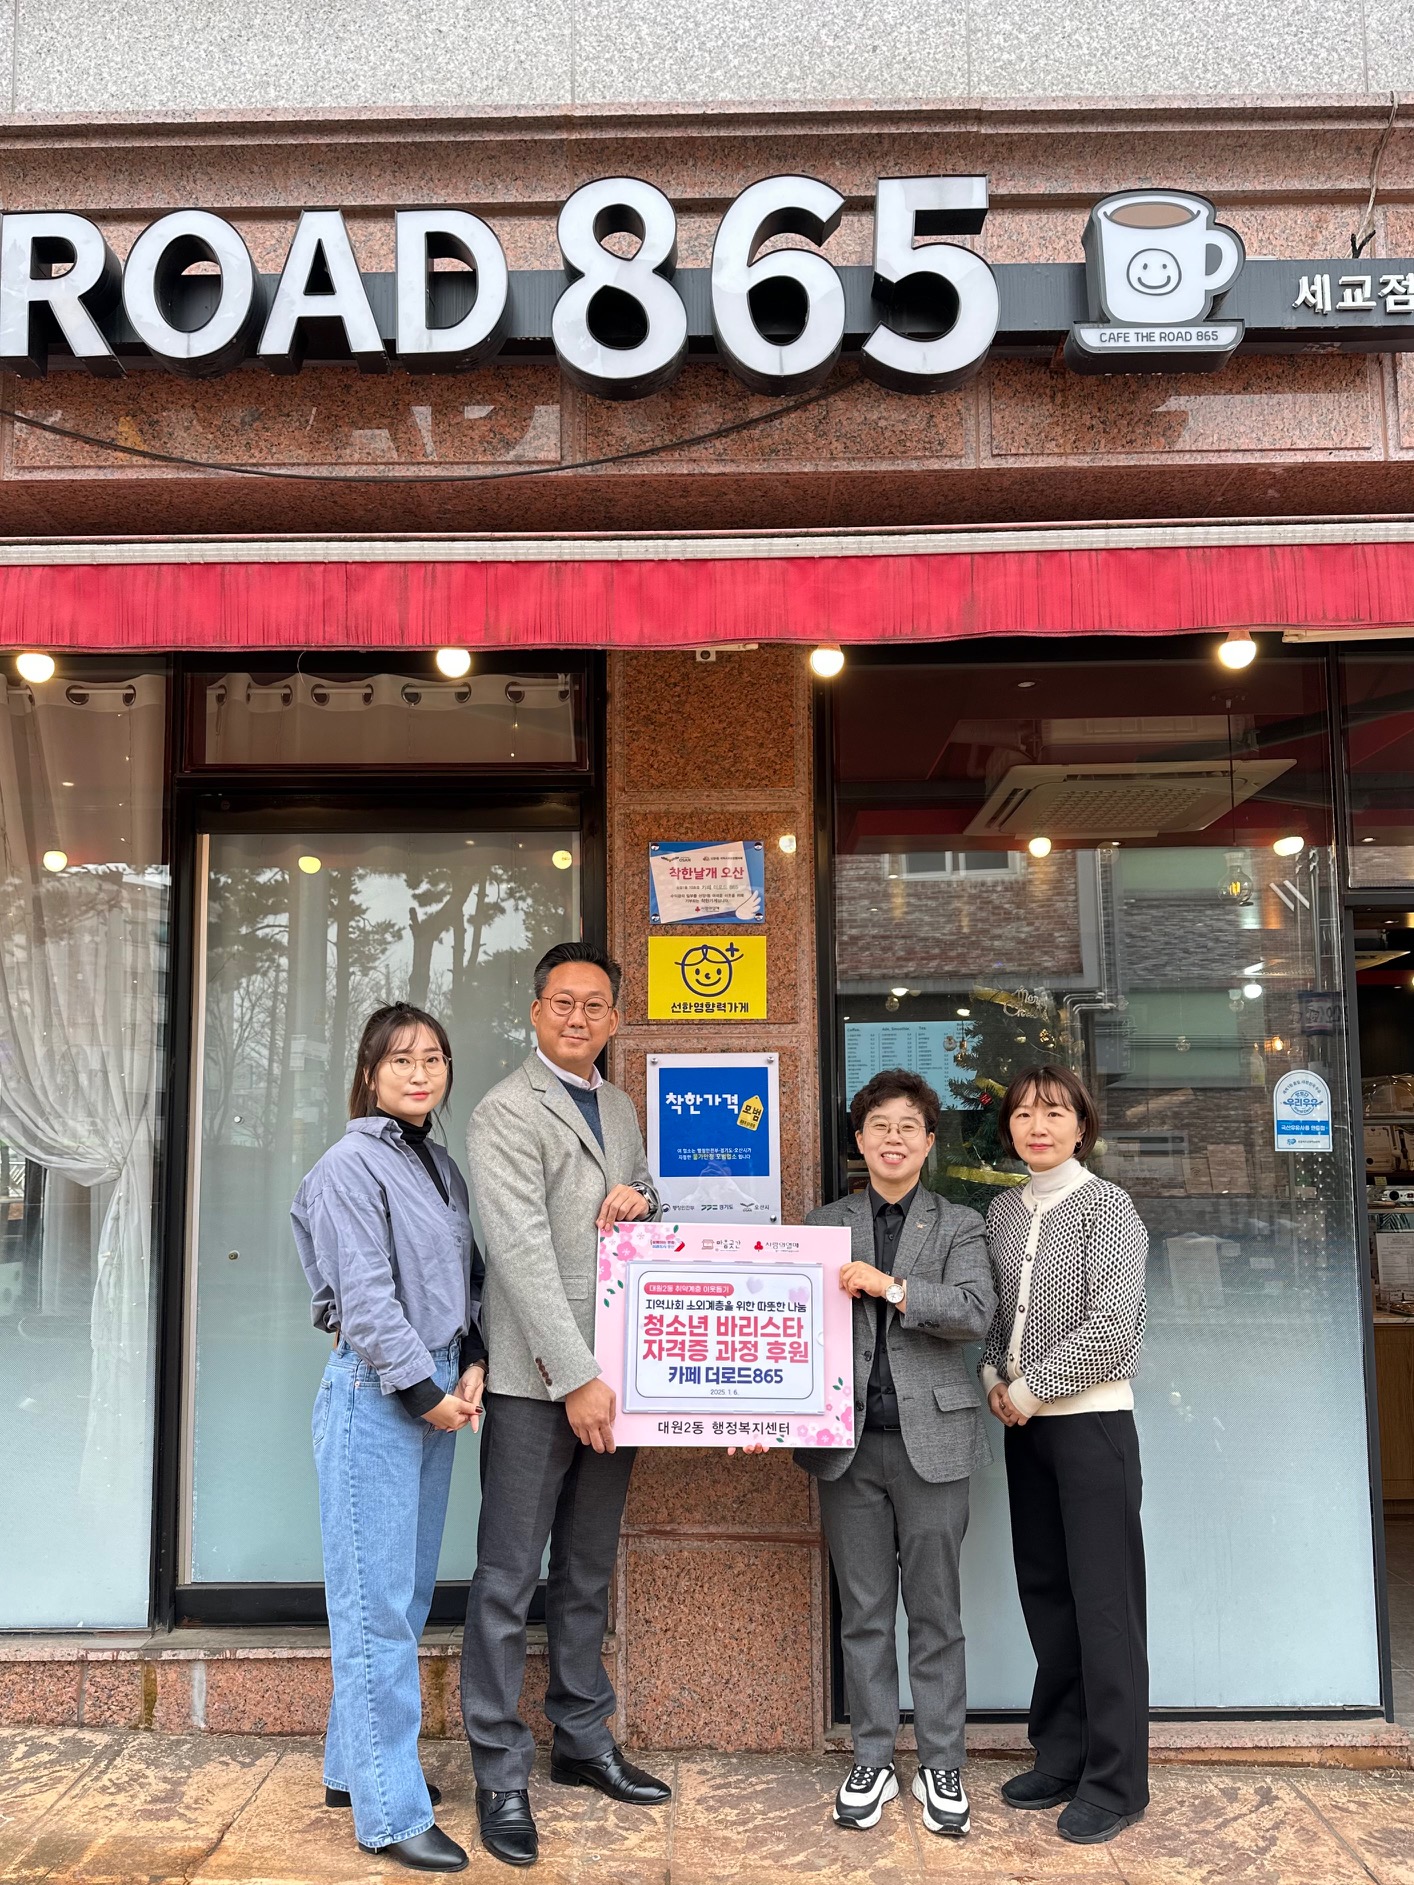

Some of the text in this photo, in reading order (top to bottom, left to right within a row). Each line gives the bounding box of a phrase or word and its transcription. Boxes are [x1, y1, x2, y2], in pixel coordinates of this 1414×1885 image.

[0, 174, 1001, 383] ROAD 865
[1292, 273, 1414, 314] 세교점
[1100, 331, 1219, 343] CAFE THE ROAD 865
[669, 867, 744, 880] 착한날개 오산
[671, 1002, 749, 1013] 선한영향력가게
[665, 1092, 739, 1115] 착한가격
[1286, 1098, 1319, 1107] 우리우유
[743, 1104, 762, 1122] 모범
[675, 1285, 701, 1293] 취약계층
[645, 1299, 807, 1313] 지역사회 소외계층을 위한 따뜻한 나눔
[643, 1314, 804, 1339] 청소년 바리스타
[642, 1339, 809, 1364] 자격증 과정 후원
[668, 1366, 784, 1385] 카페 더로드865
[658, 1421, 790, 1436] 대원2동 행정복지센터
